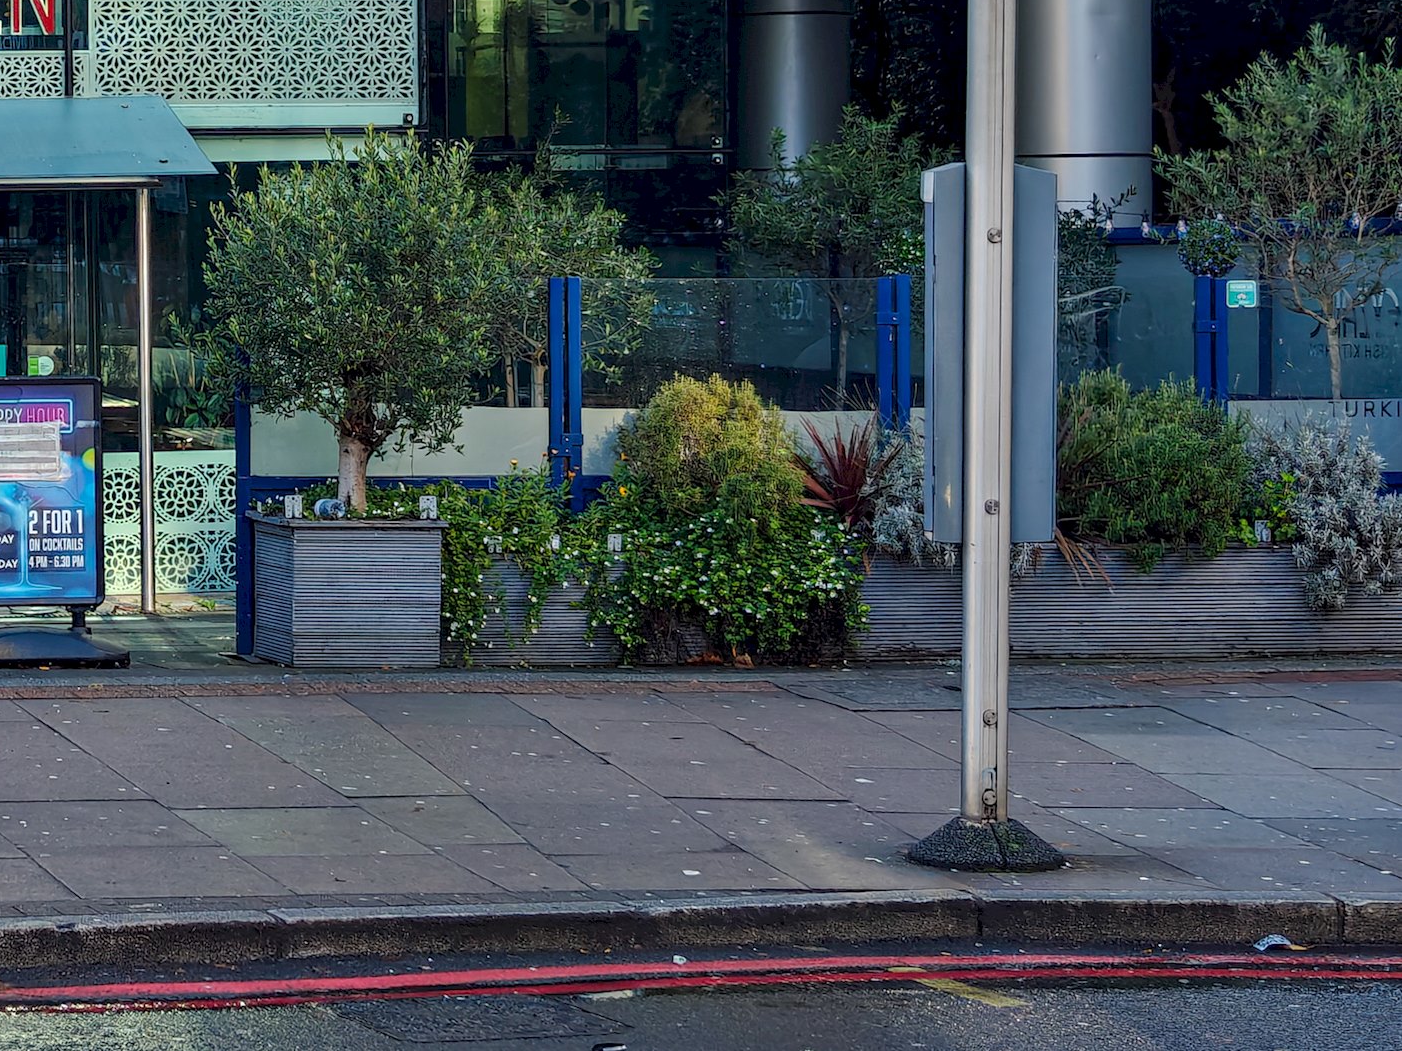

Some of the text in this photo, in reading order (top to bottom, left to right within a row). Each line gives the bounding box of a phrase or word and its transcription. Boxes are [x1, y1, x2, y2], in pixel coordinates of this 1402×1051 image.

[27, 407, 66, 425] HOUR
[29, 509, 83, 534] 2 FOR 1
[29, 537, 83, 551] ON COCKTAILS
[29, 556, 34, 568] 4
[35, 556, 48, 568] PM
[54, 556, 70, 568] 6.30
[72, 555, 84, 568] PM
